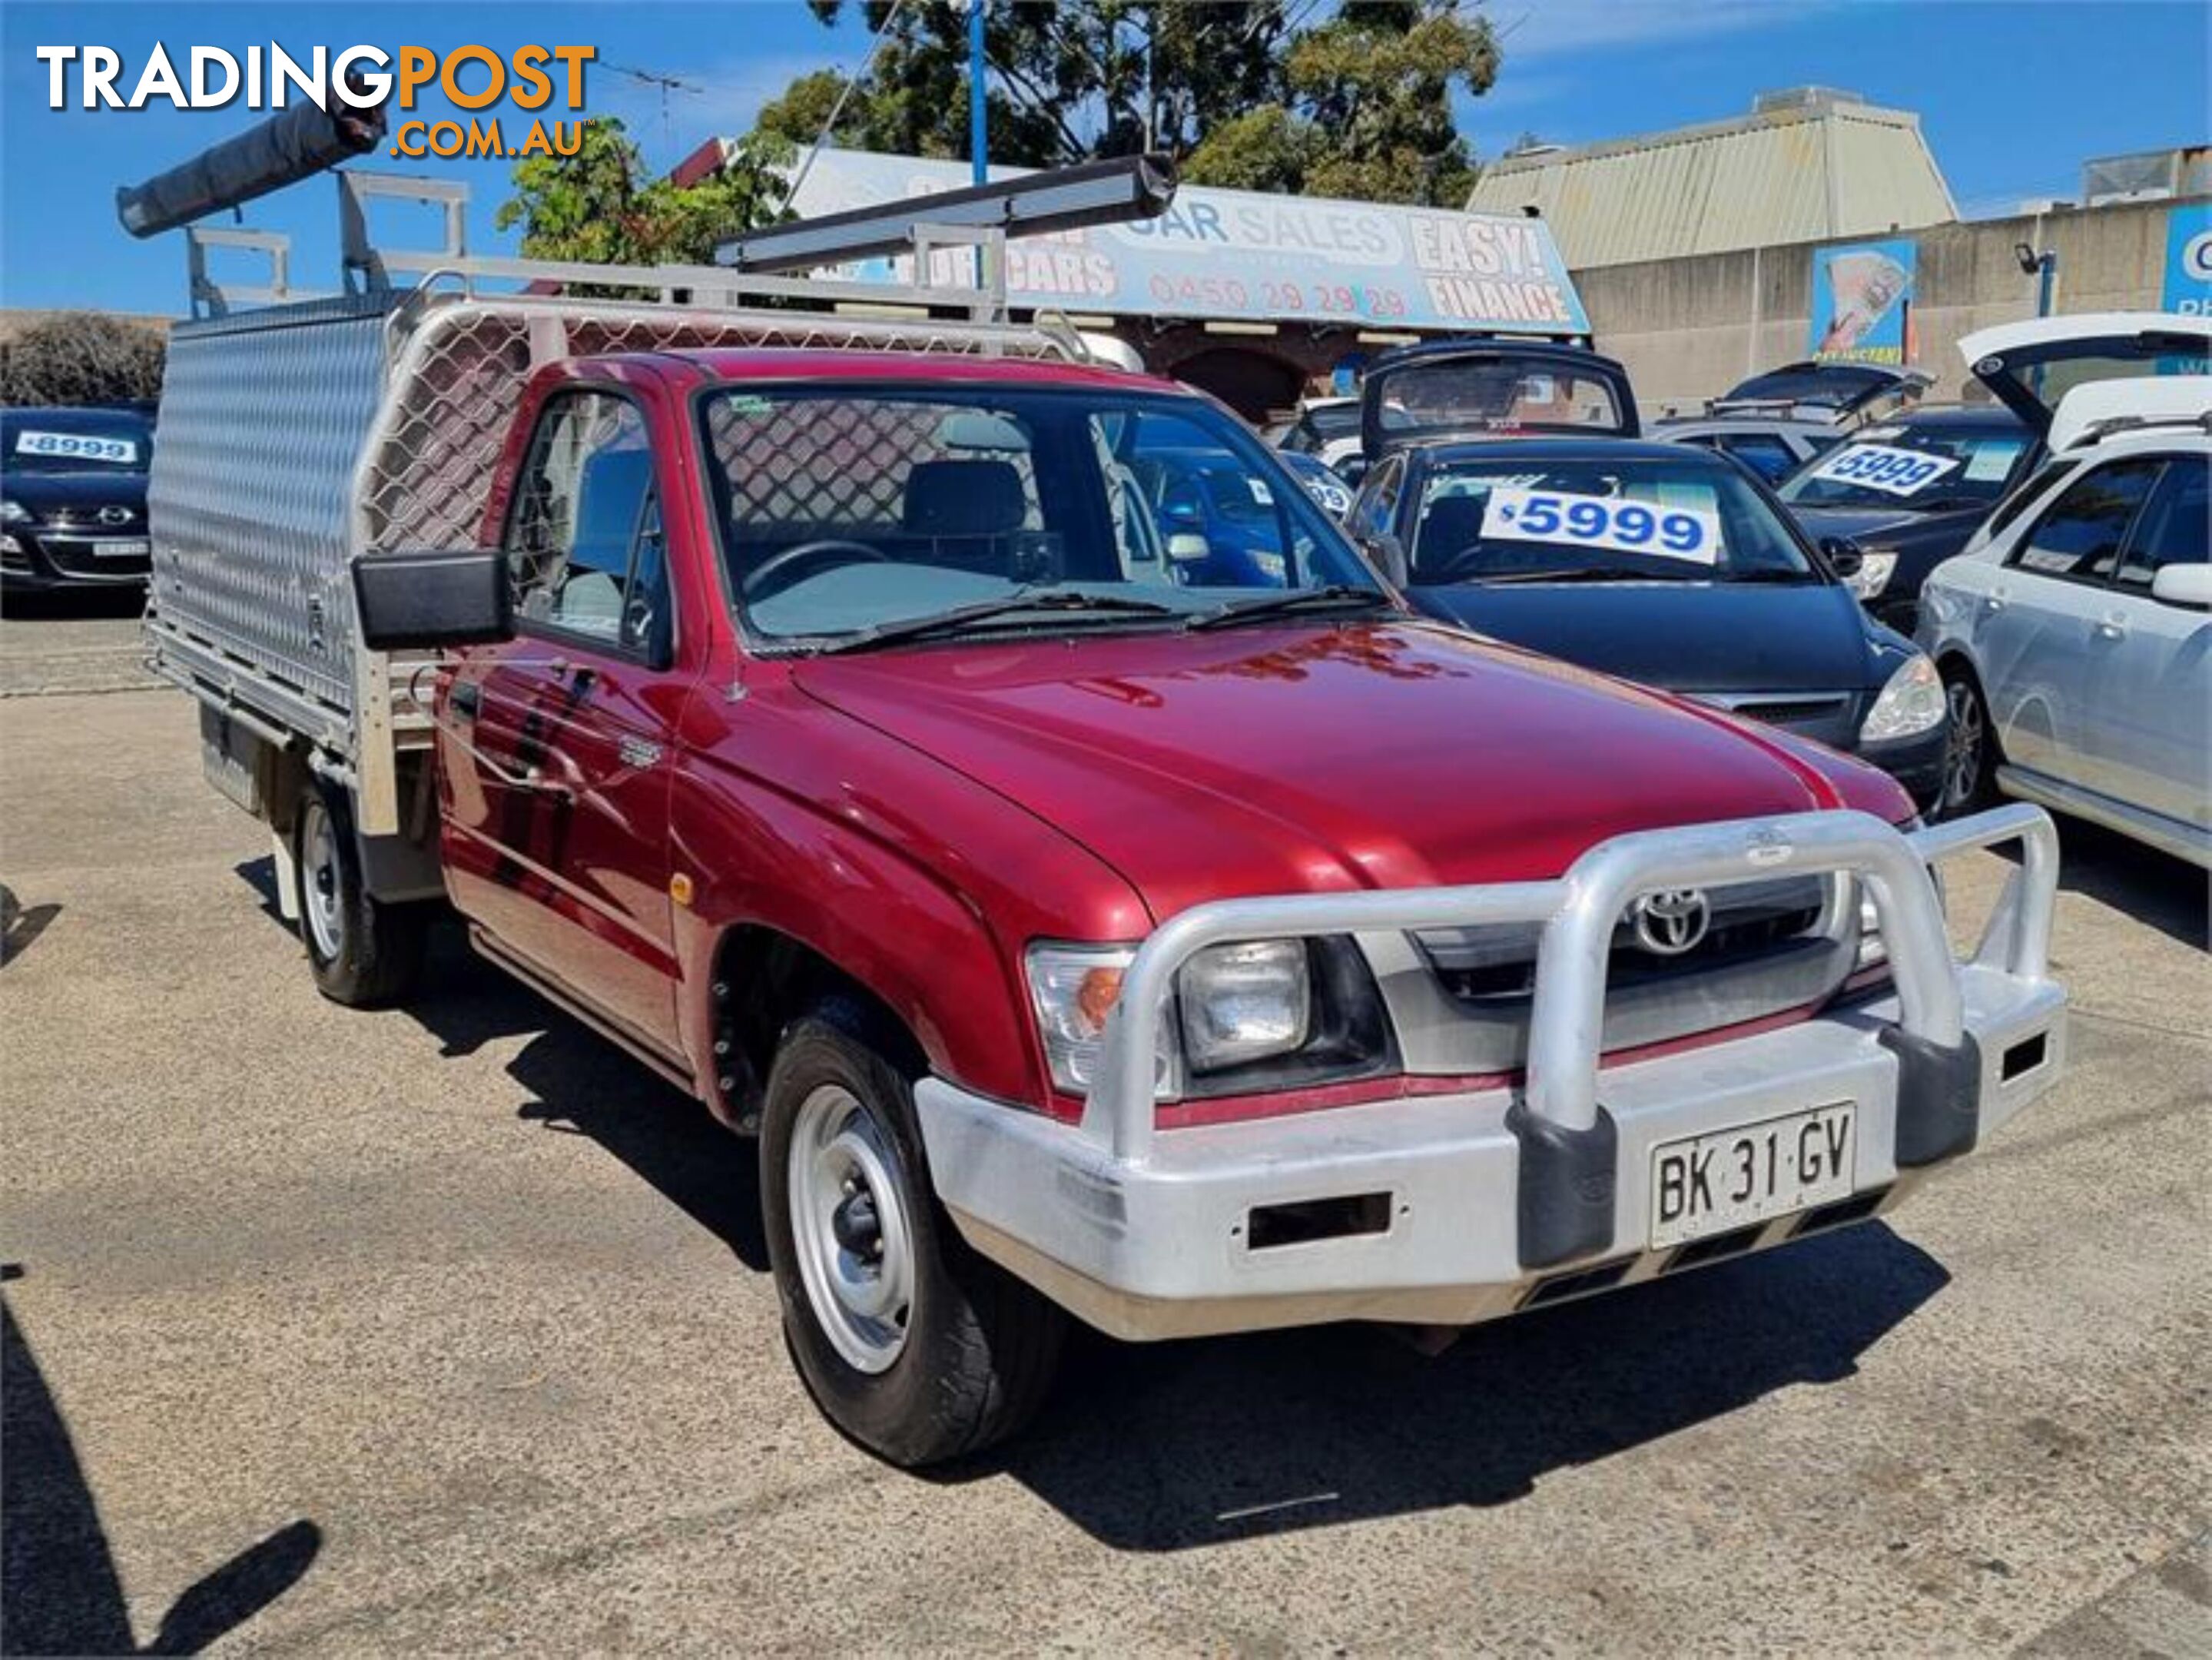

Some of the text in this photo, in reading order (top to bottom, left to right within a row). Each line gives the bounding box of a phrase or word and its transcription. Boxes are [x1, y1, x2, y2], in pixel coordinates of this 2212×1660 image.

[1235, 205, 1386, 254] SALES
[1411, 215, 1544, 277] EASY!
[1006, 250, 1118, 297] CARS
[1426, 275, 1570, 322] FINANCE
[1501, 496, 1703, 552] $5999
[1660, 1114, 1849, 1223] BK 31 GV
